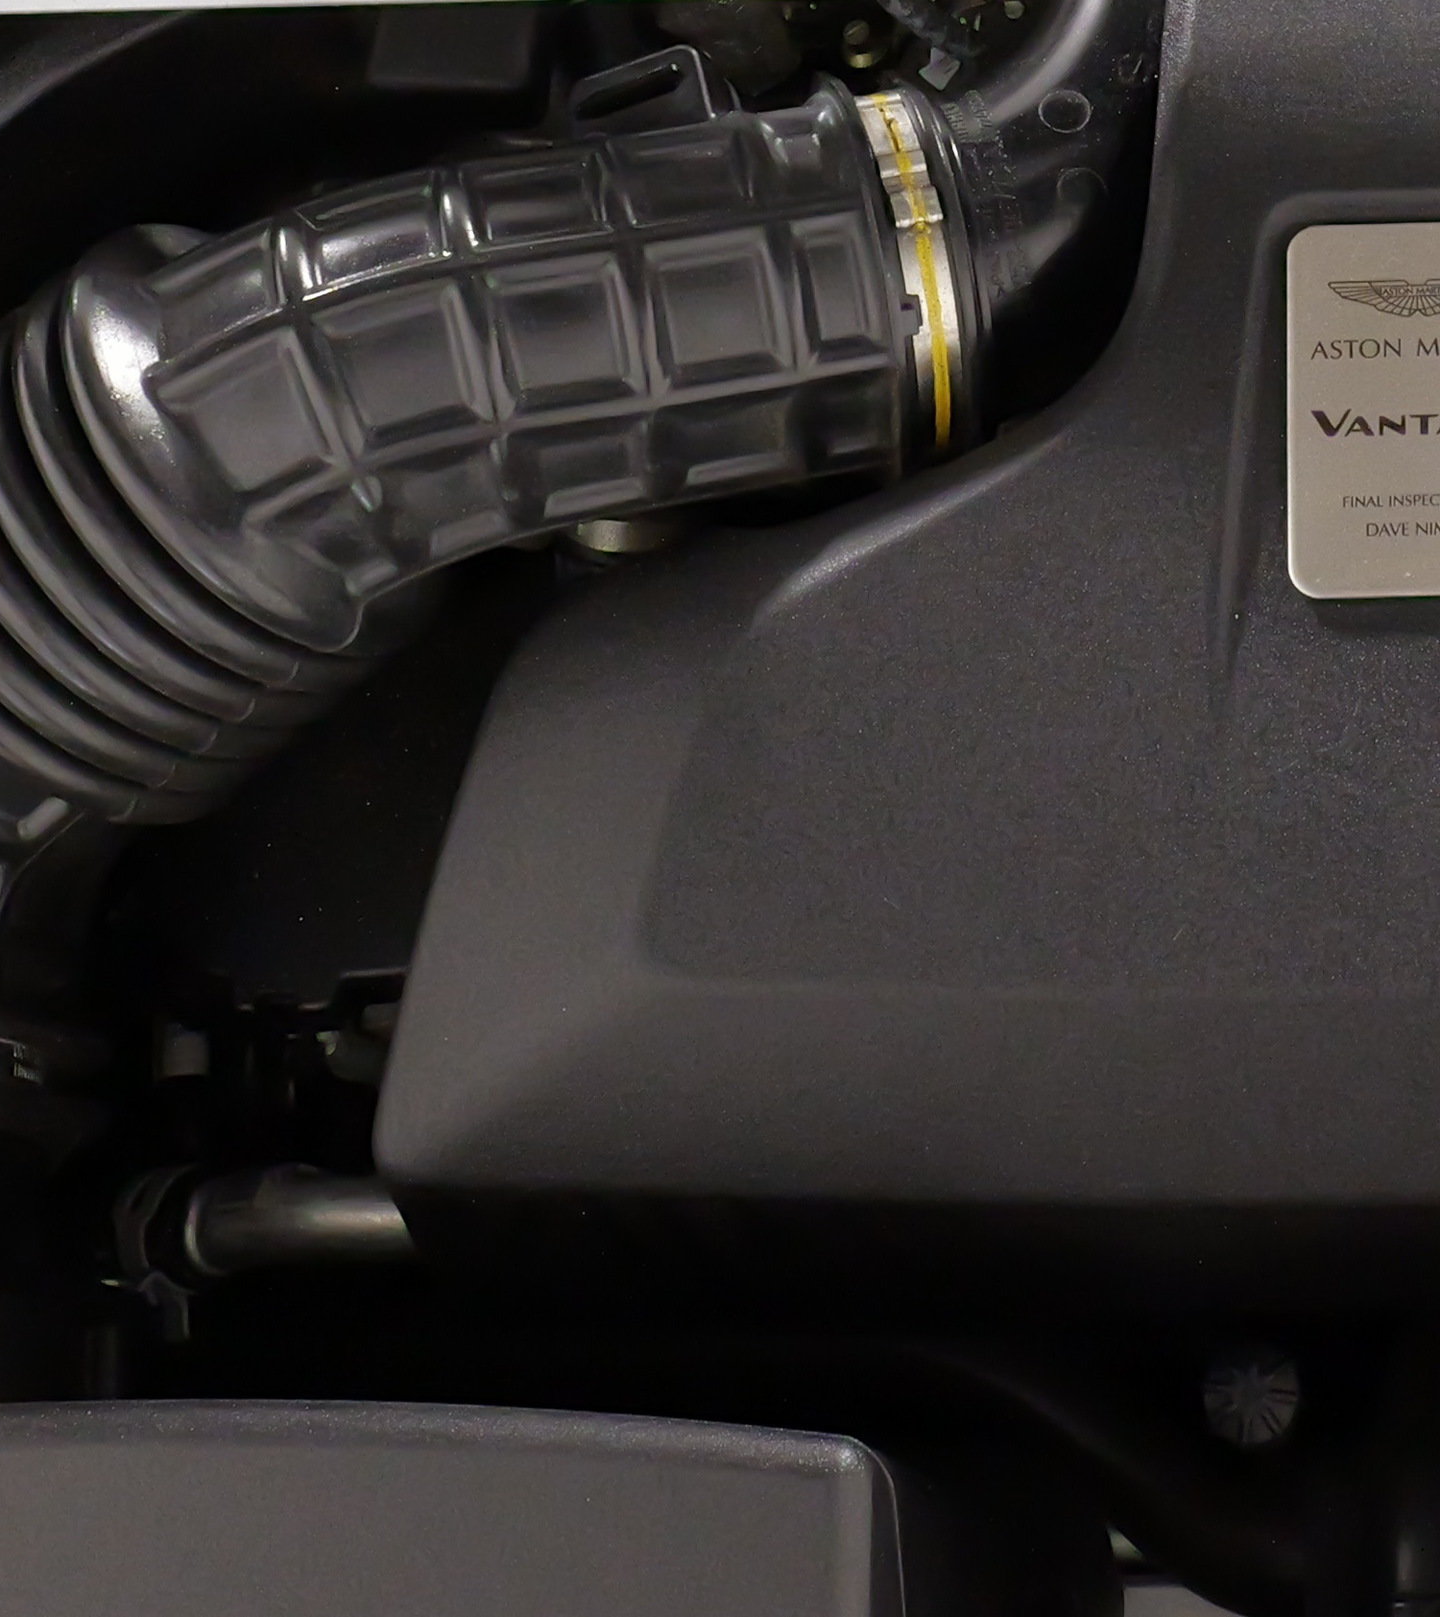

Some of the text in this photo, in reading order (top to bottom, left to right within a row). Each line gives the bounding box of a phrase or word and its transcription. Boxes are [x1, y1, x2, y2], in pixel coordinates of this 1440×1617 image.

[1380, 286, 1414, 297] ASTON
[1311, 338, 1402, 360] ASTON
[1342, 495, 1384, 508] FINAL
[1365, 521, 1410, 537] DAVE
